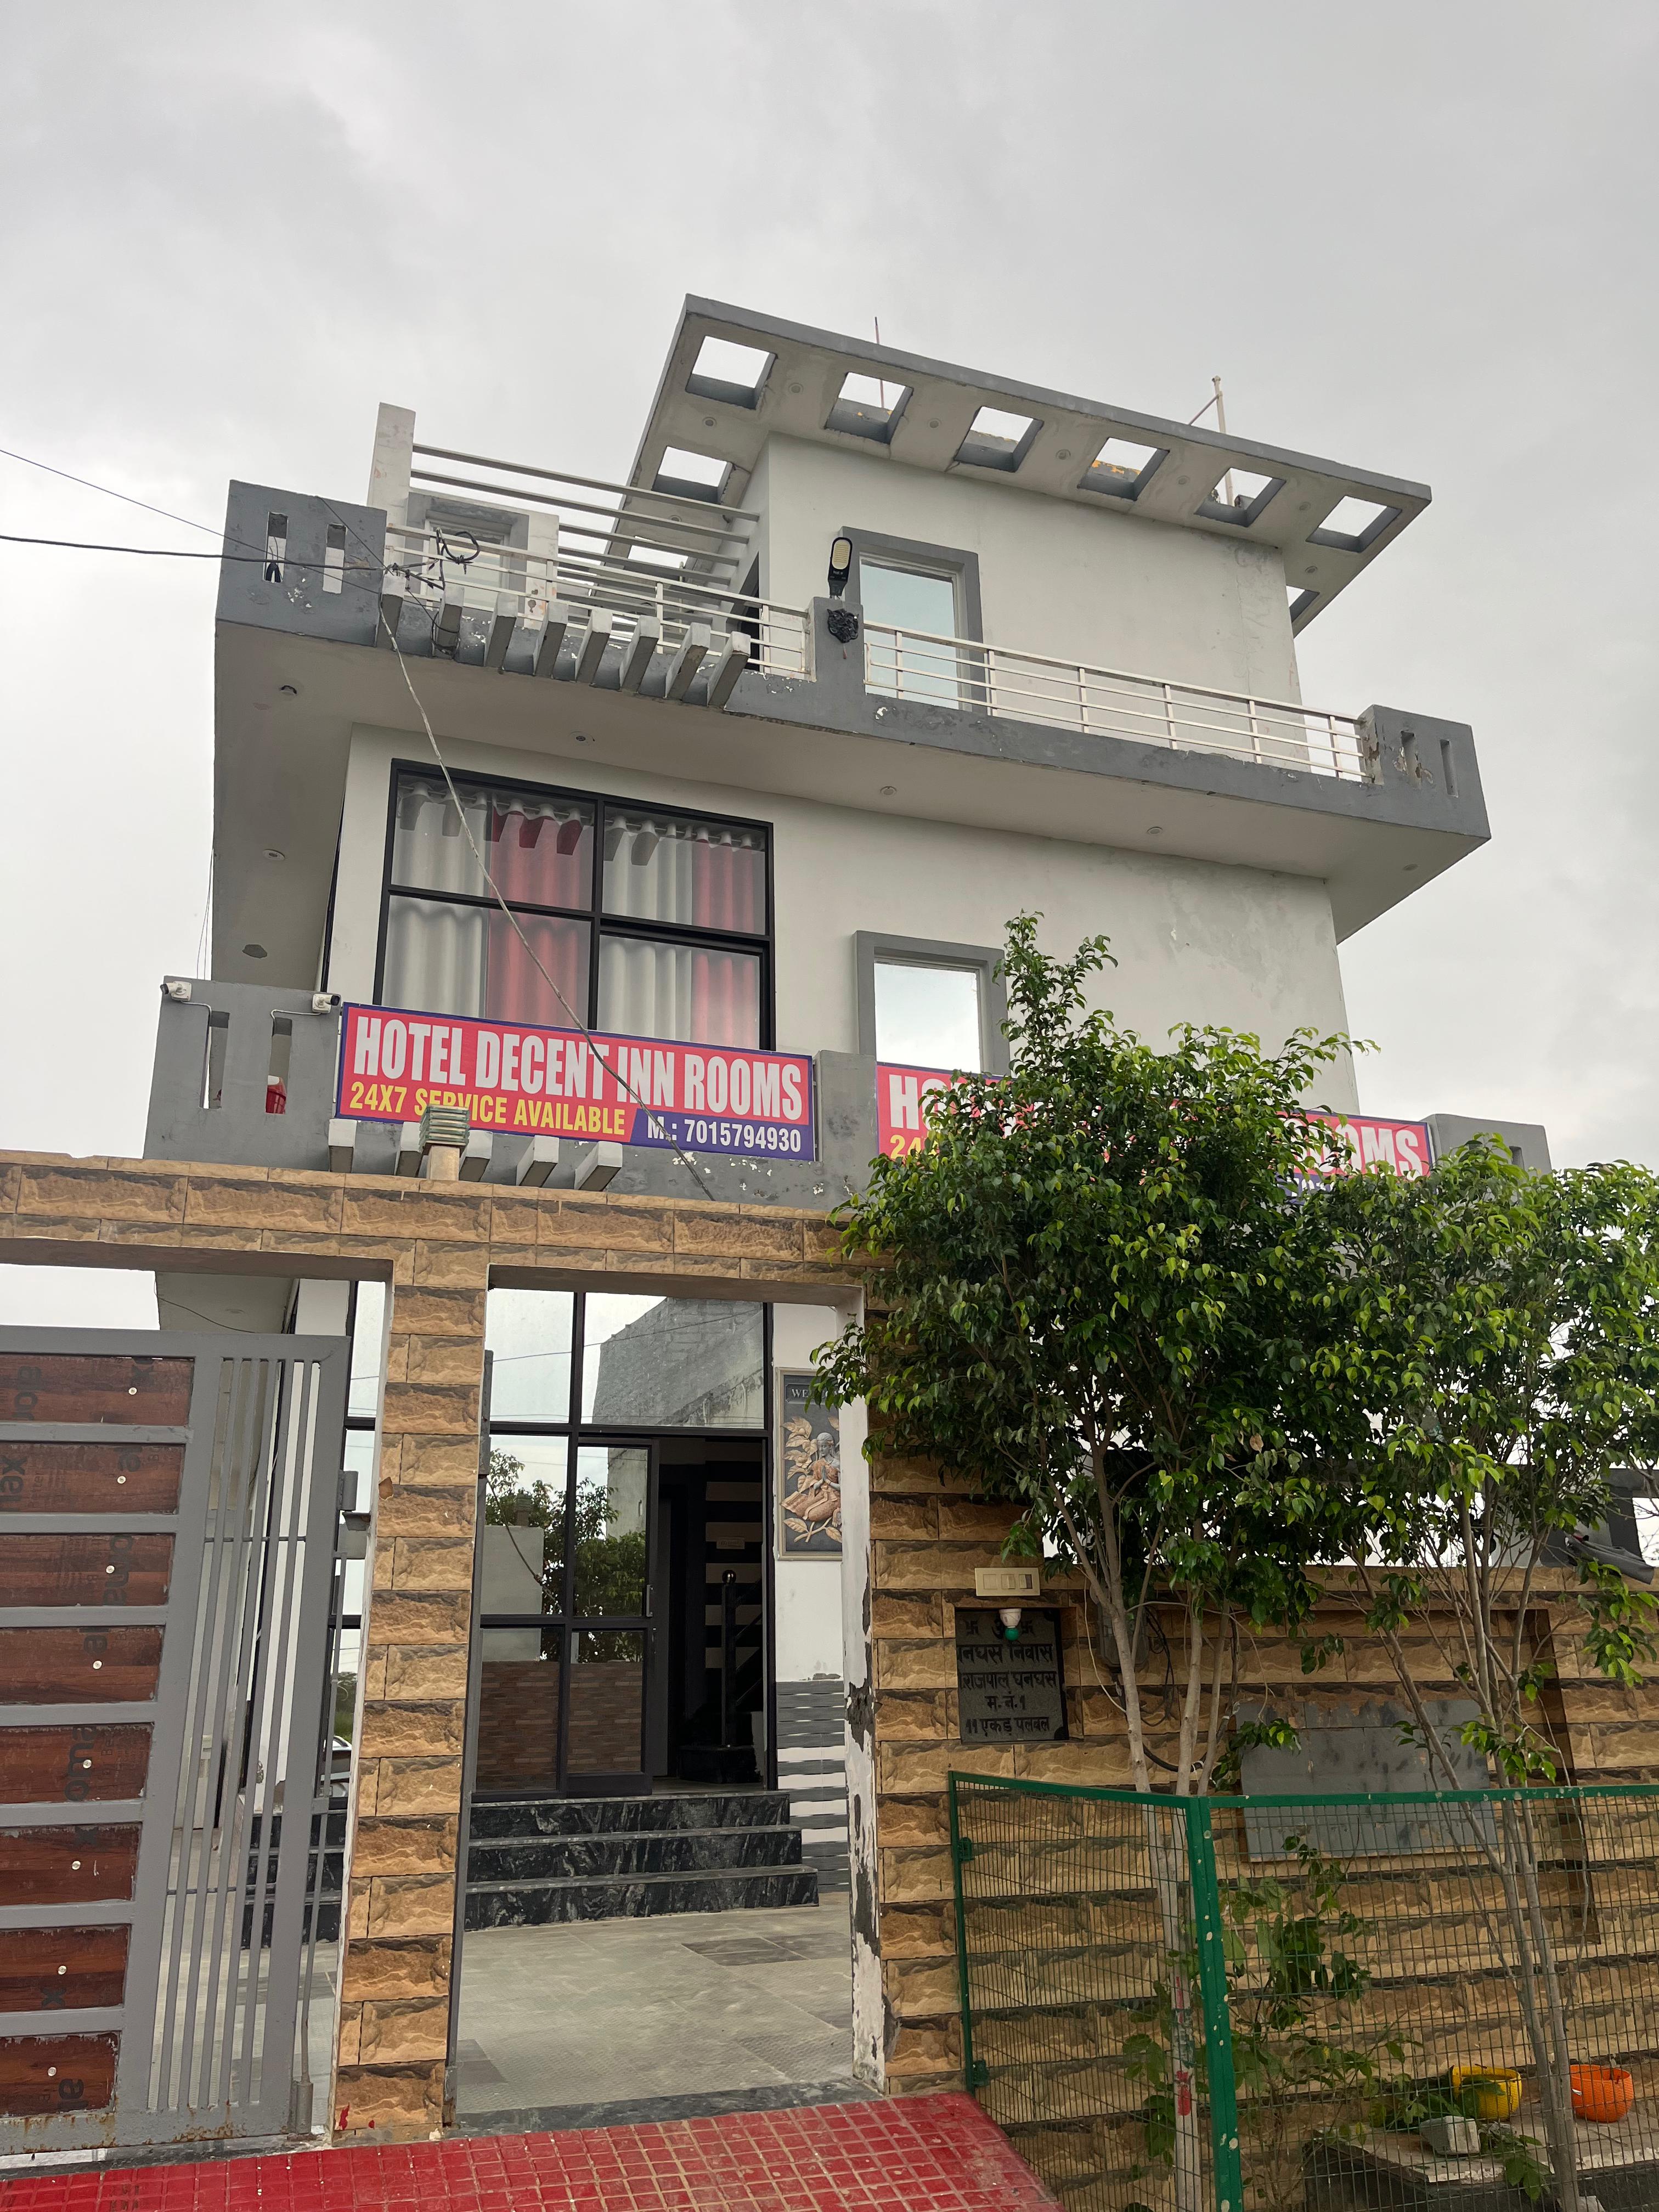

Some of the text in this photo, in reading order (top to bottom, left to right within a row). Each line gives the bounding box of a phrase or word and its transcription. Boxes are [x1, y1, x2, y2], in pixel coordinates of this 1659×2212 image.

[354, 1016, 802, 1121] HOTEL DECENT INN ROOMS
[349, 1081, 408, 1113] 24X7
[513, 1099, 625, 1136] AVAILABLE
[684, 1119, 802, 1153] 7015794930
